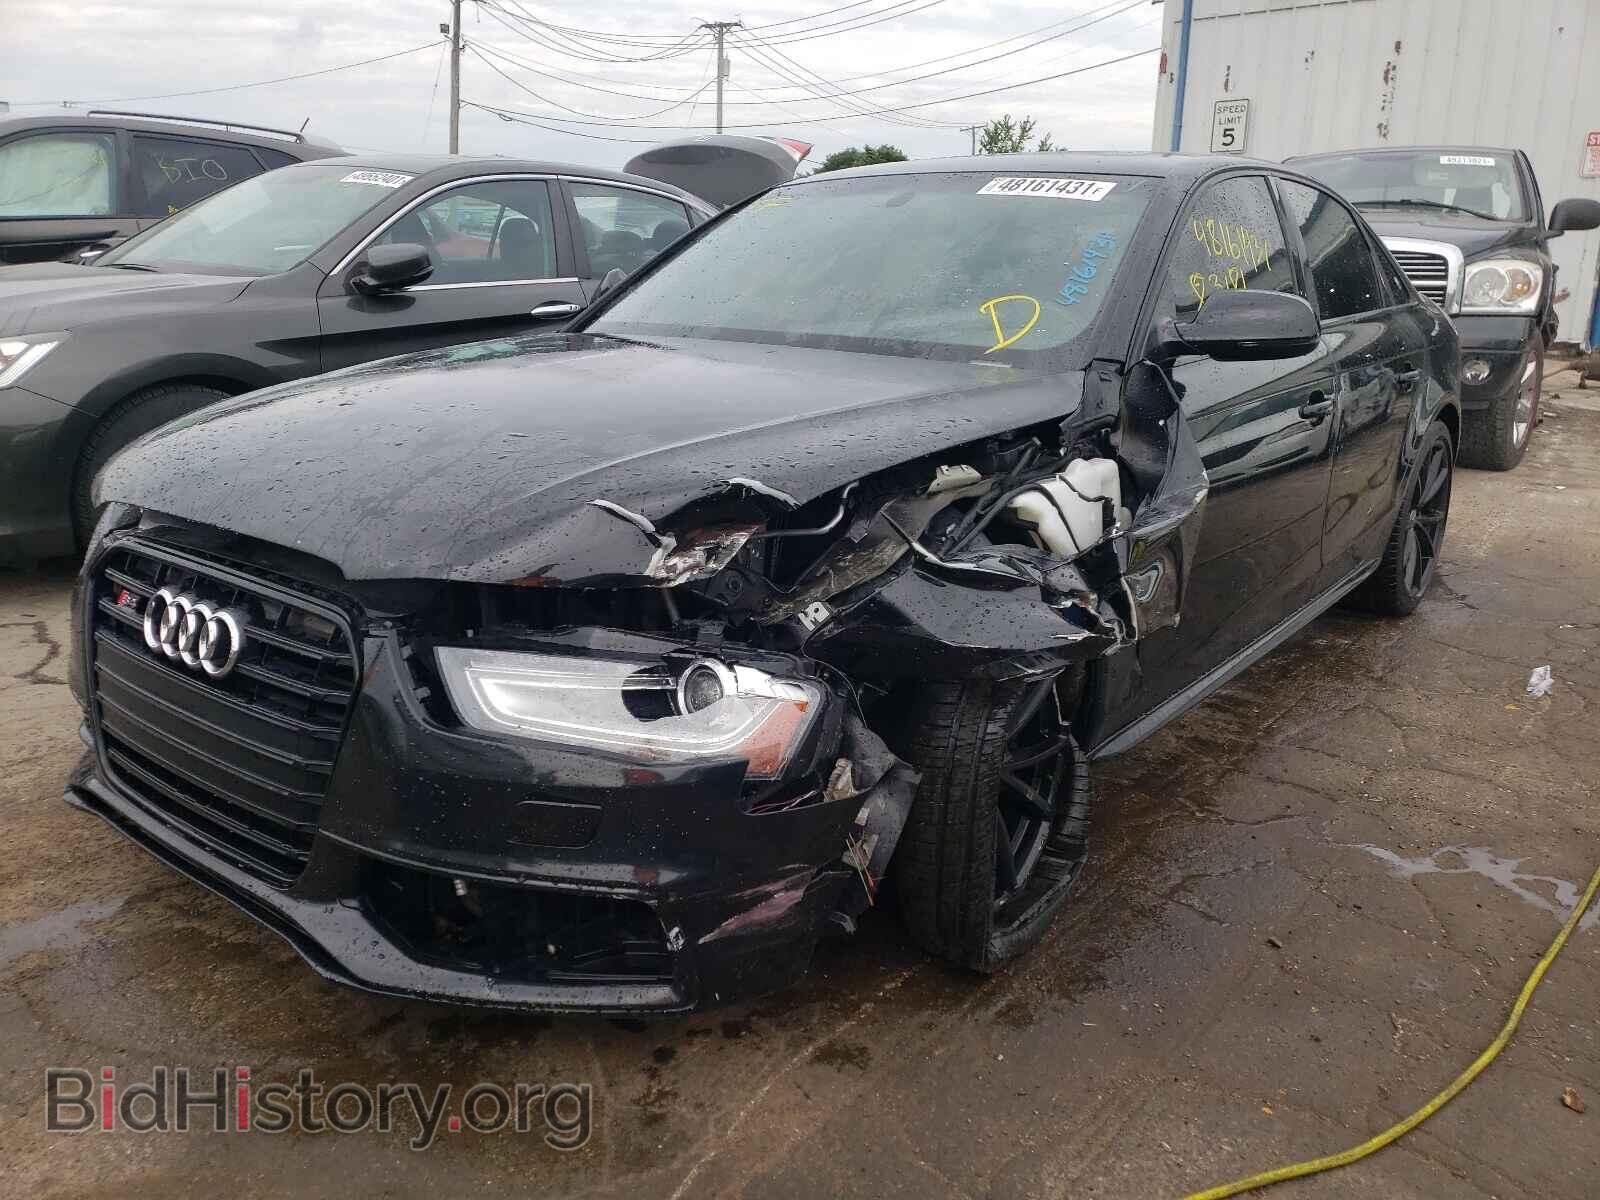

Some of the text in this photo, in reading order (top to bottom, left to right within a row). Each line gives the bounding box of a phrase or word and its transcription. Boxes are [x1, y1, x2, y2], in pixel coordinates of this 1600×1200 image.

[1216, 104, 1245, 113] SPEED
[1218, 116, 1241, 125] LIMIT
[1221, 128, 1235, 147] 5
[998, 178, 1097, 196] 48161431
[979, 295, 1041, 355] D
